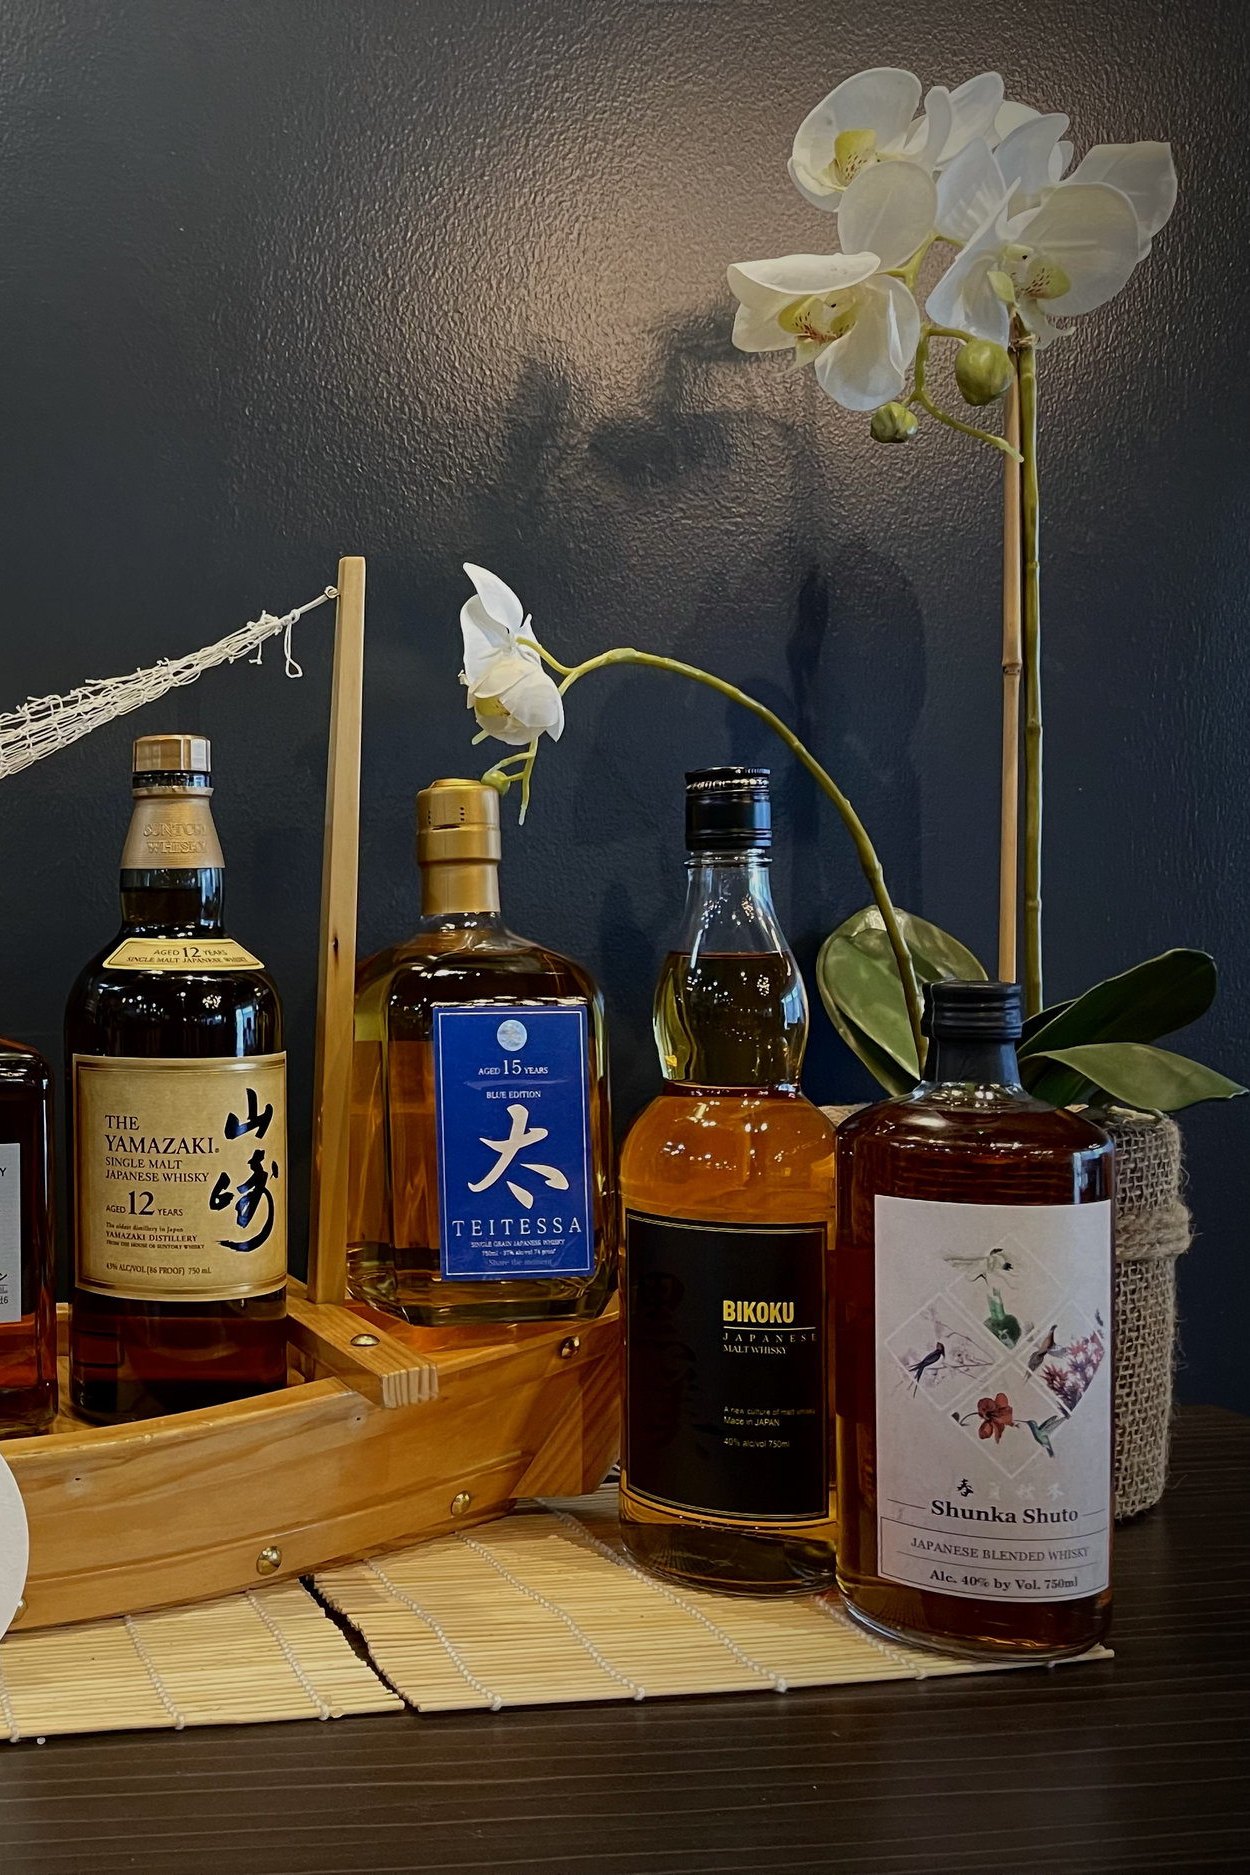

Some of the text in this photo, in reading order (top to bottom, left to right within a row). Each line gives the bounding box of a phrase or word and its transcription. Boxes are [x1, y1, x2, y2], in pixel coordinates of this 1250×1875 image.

[182, 947, 201, 958] 12
[504, 1059, 522, 1075] 15
[524, 1066, 548, 1074] YEARS
[486, 1090, 541, 1099] BLUE EDITION
[105, 1115, 140, 1131] THE
[105, 1157, 183, 1170] SINGLE MALT
[467, 1104, 569, 1210] 太
[105, 1169, 209, 1183] JAPANESE WHISKY
[105, 1191, 184, 1217] AGED 12 YEARS
[167, 1226, 184, 1234] Japan
[451, 1216, 582, 1237] TEITESSA
[106, 1230, 198, 1242] YAMAZAKI DISTILLERY
[159, 1267, 185, 1275] PROOF)
[188, 1267, 200, 1275] 750
[723, 1300, 795, 1324] BIKOKU
[722, 1332, 817, 1343] JAPANESE
[723, 1344, 787, 1354] MALT WHISKY
[724, 1416, 780, 1427] Made in JAPAN
[724, 1437, 741, 1447] 40%
[931, 1500, 1079, 1524] Shunka Shuto
[910, 1537, 1090, 1562] JAPANESE BLENDED WHISKY
[930, 1569, 1079, 1592] Alc. 40% by Vol. 750ml
